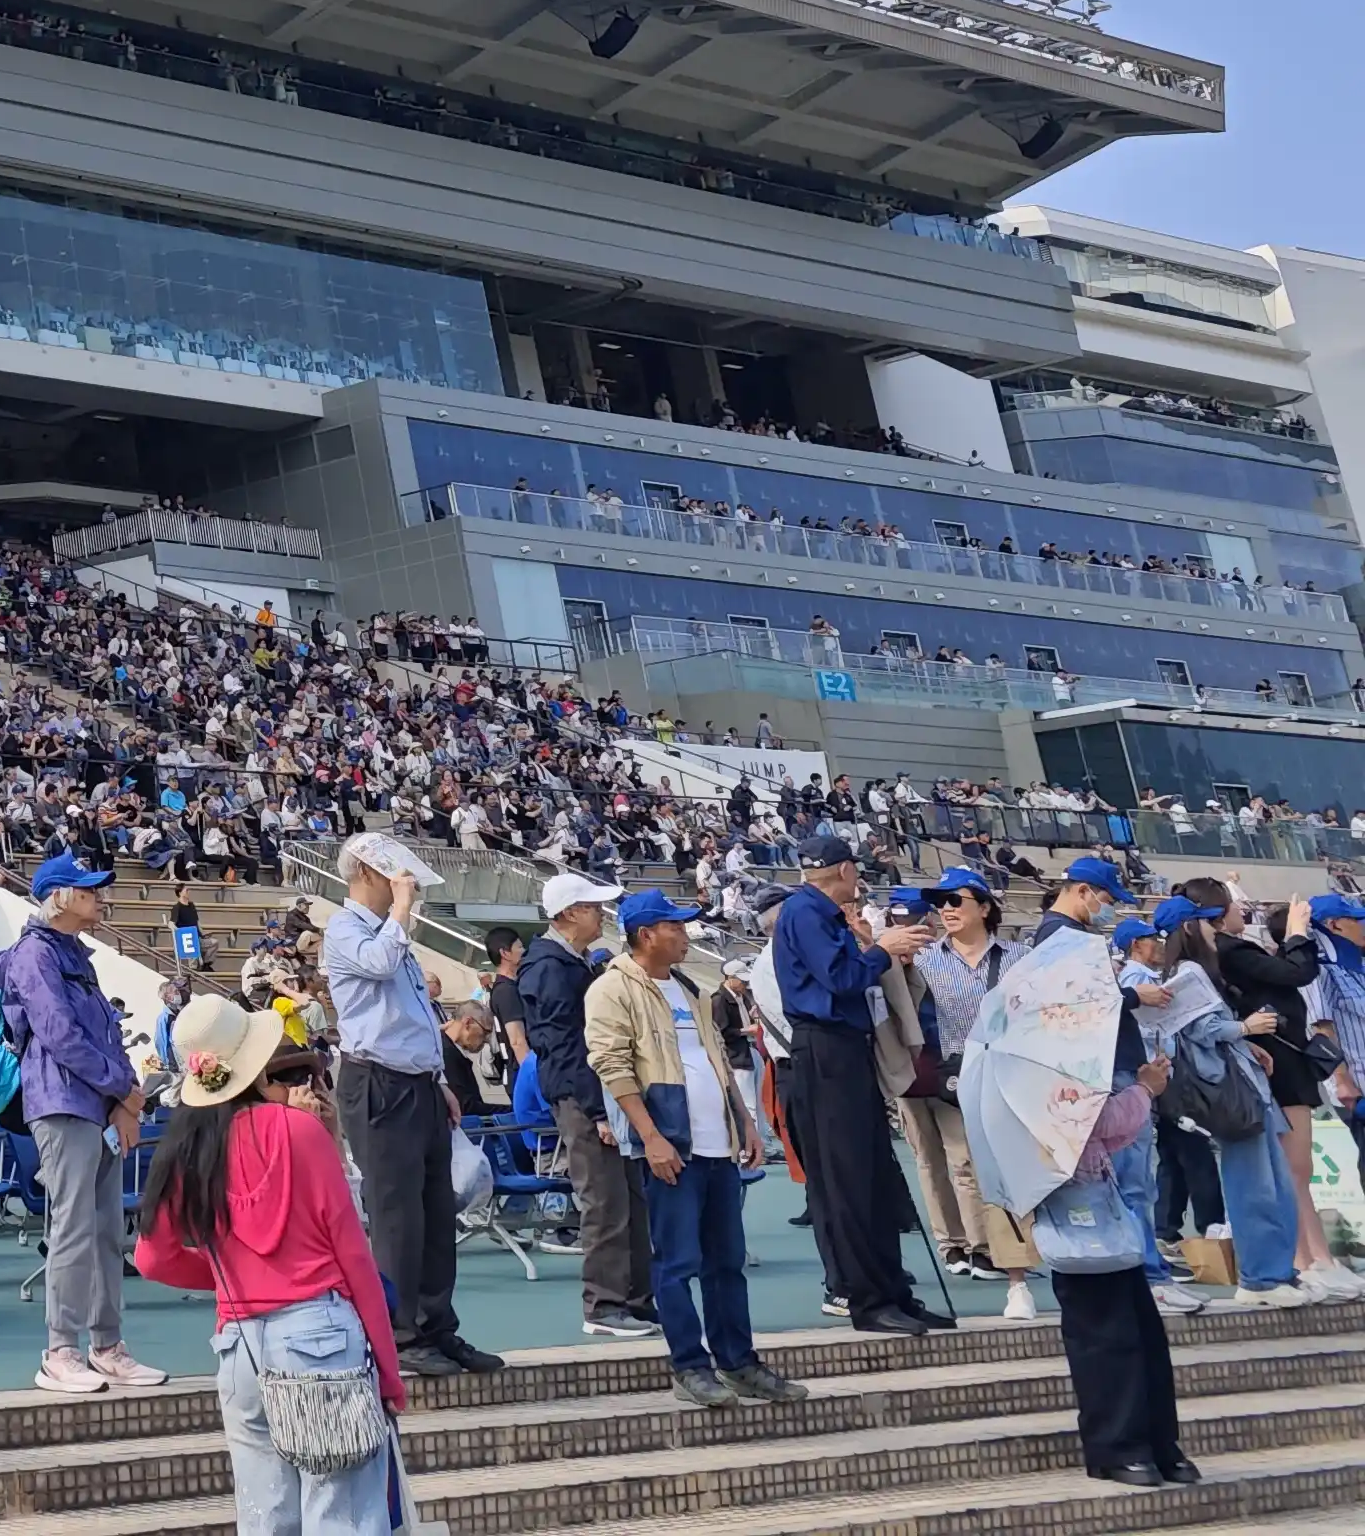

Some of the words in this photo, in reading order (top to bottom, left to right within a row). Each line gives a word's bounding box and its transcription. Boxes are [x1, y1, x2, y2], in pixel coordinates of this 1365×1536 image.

[821, 672, 850, 692] E2
[740, 760, 787, 778] JUMP
[181, 933, 196, 953] E
